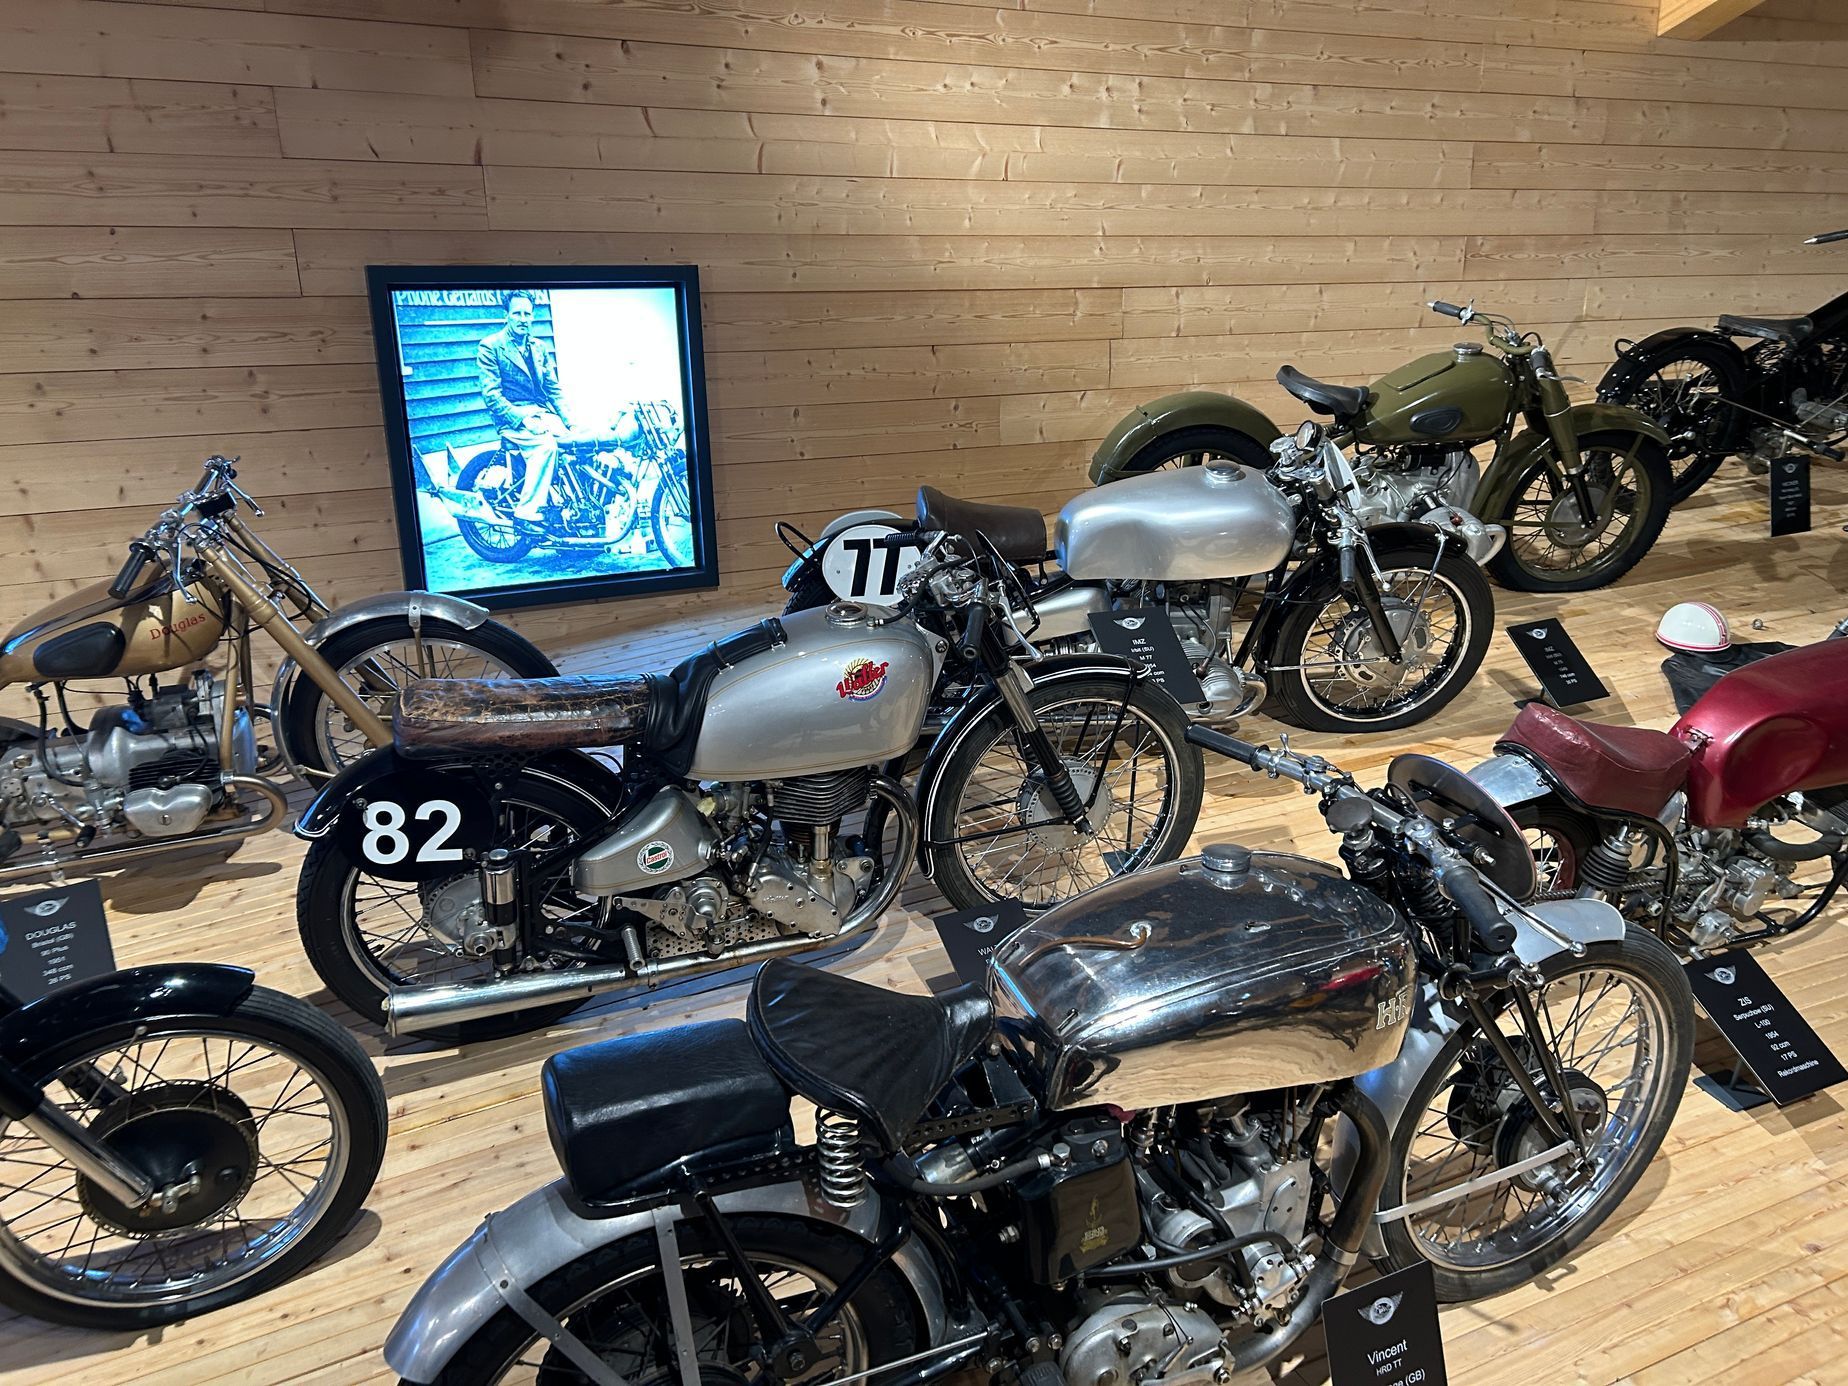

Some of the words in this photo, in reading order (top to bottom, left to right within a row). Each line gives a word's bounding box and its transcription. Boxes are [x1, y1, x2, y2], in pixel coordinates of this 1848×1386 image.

[842, 537, 903, 597] 77
[149, 613, 206, 640] Douglas
[362, 800, 463, 865] 82
[646, 850, 668, 864] Castrol
[25, 921, 77, 941] DOUGLAS
[1778, 1041, 1791, 1050] ccm
[1787, 1050, 1798, 1059] PS
[1777, 1060, 1819, 1078] Rekordmaschine
[1367, 1339, 1408, 1365] Vincent
[1376, 1362, 1393, 1377] HRD
[1392, 1358, 1402, 1369] TT
[1405, 1368, 1426, 1386] (GB)
